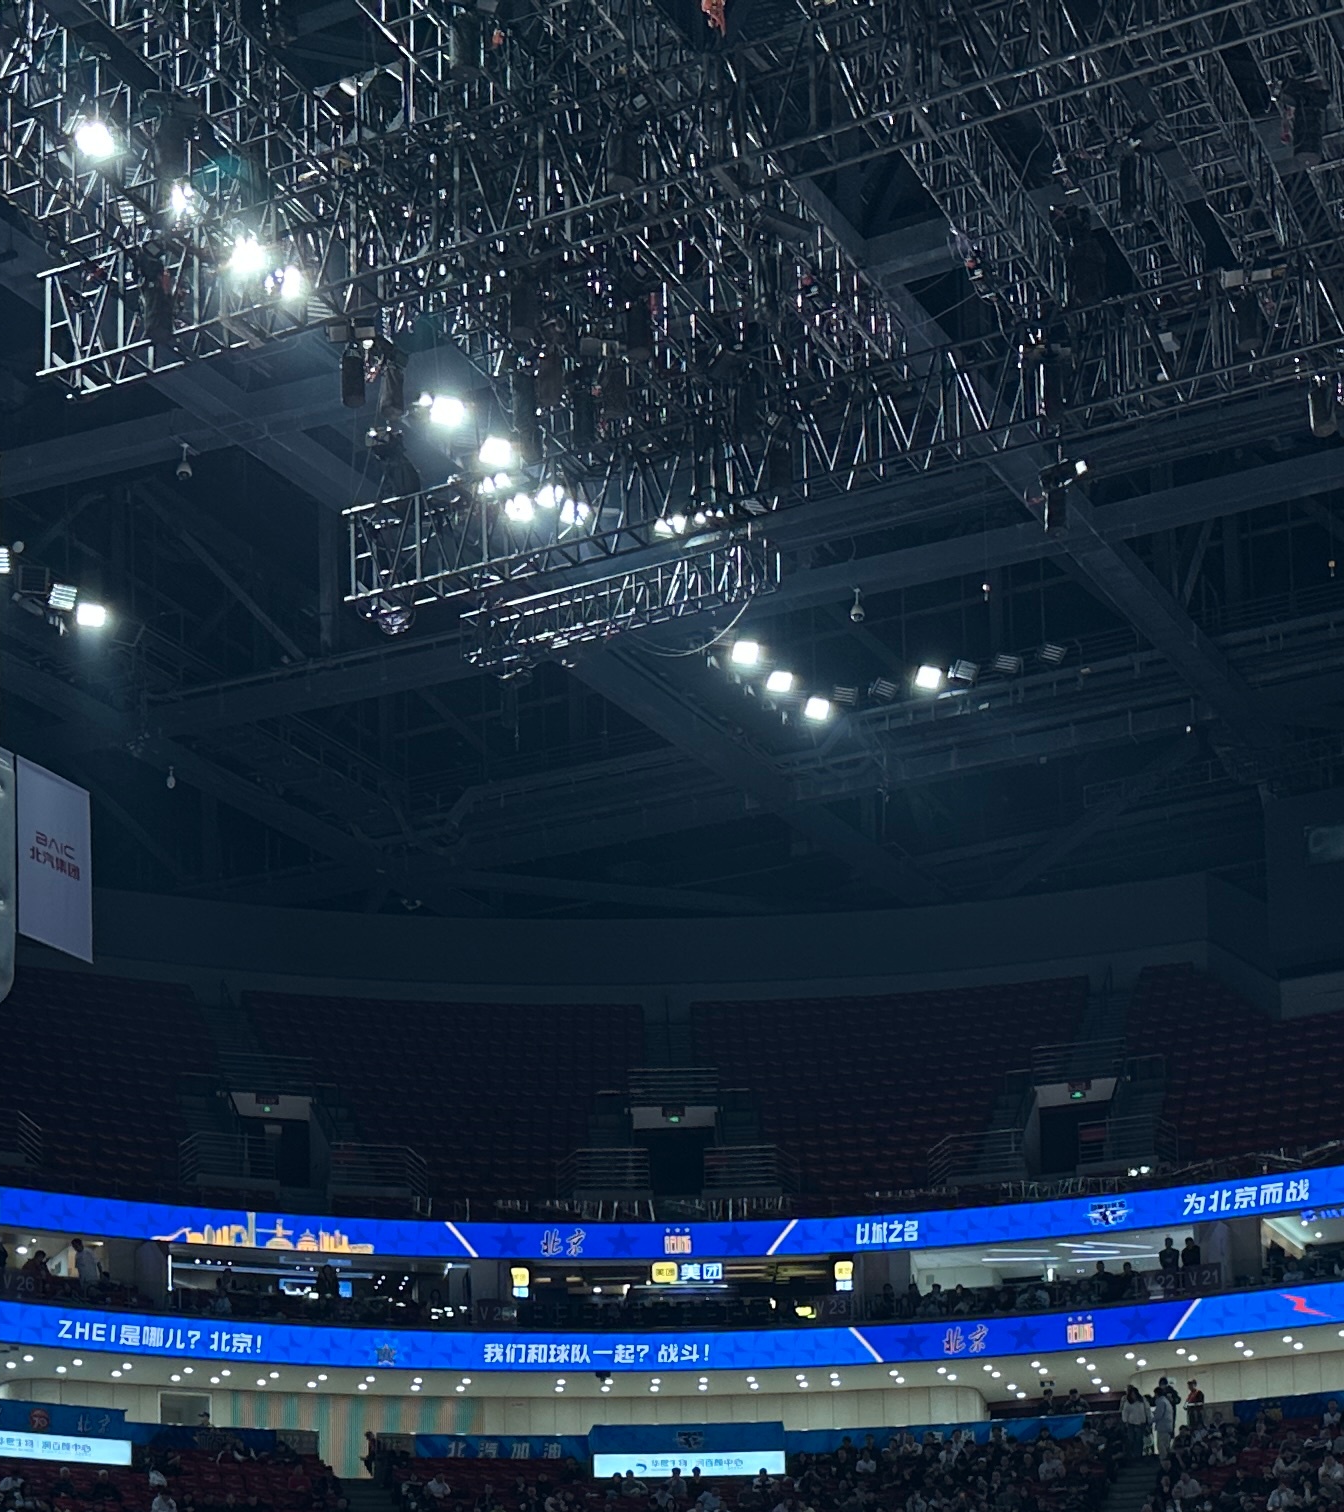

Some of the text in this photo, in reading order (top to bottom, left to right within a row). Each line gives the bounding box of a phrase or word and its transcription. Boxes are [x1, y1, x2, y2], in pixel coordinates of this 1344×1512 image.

[1184, 1179, 1310, 1216] 为北京而战
[540, 1228, 586, 1258] 北京
[855, 1220, 919, 1245] 以城之名
[680, 1262, 724, 1282] 美团
[944, 1325, 988, 1354] 北京
